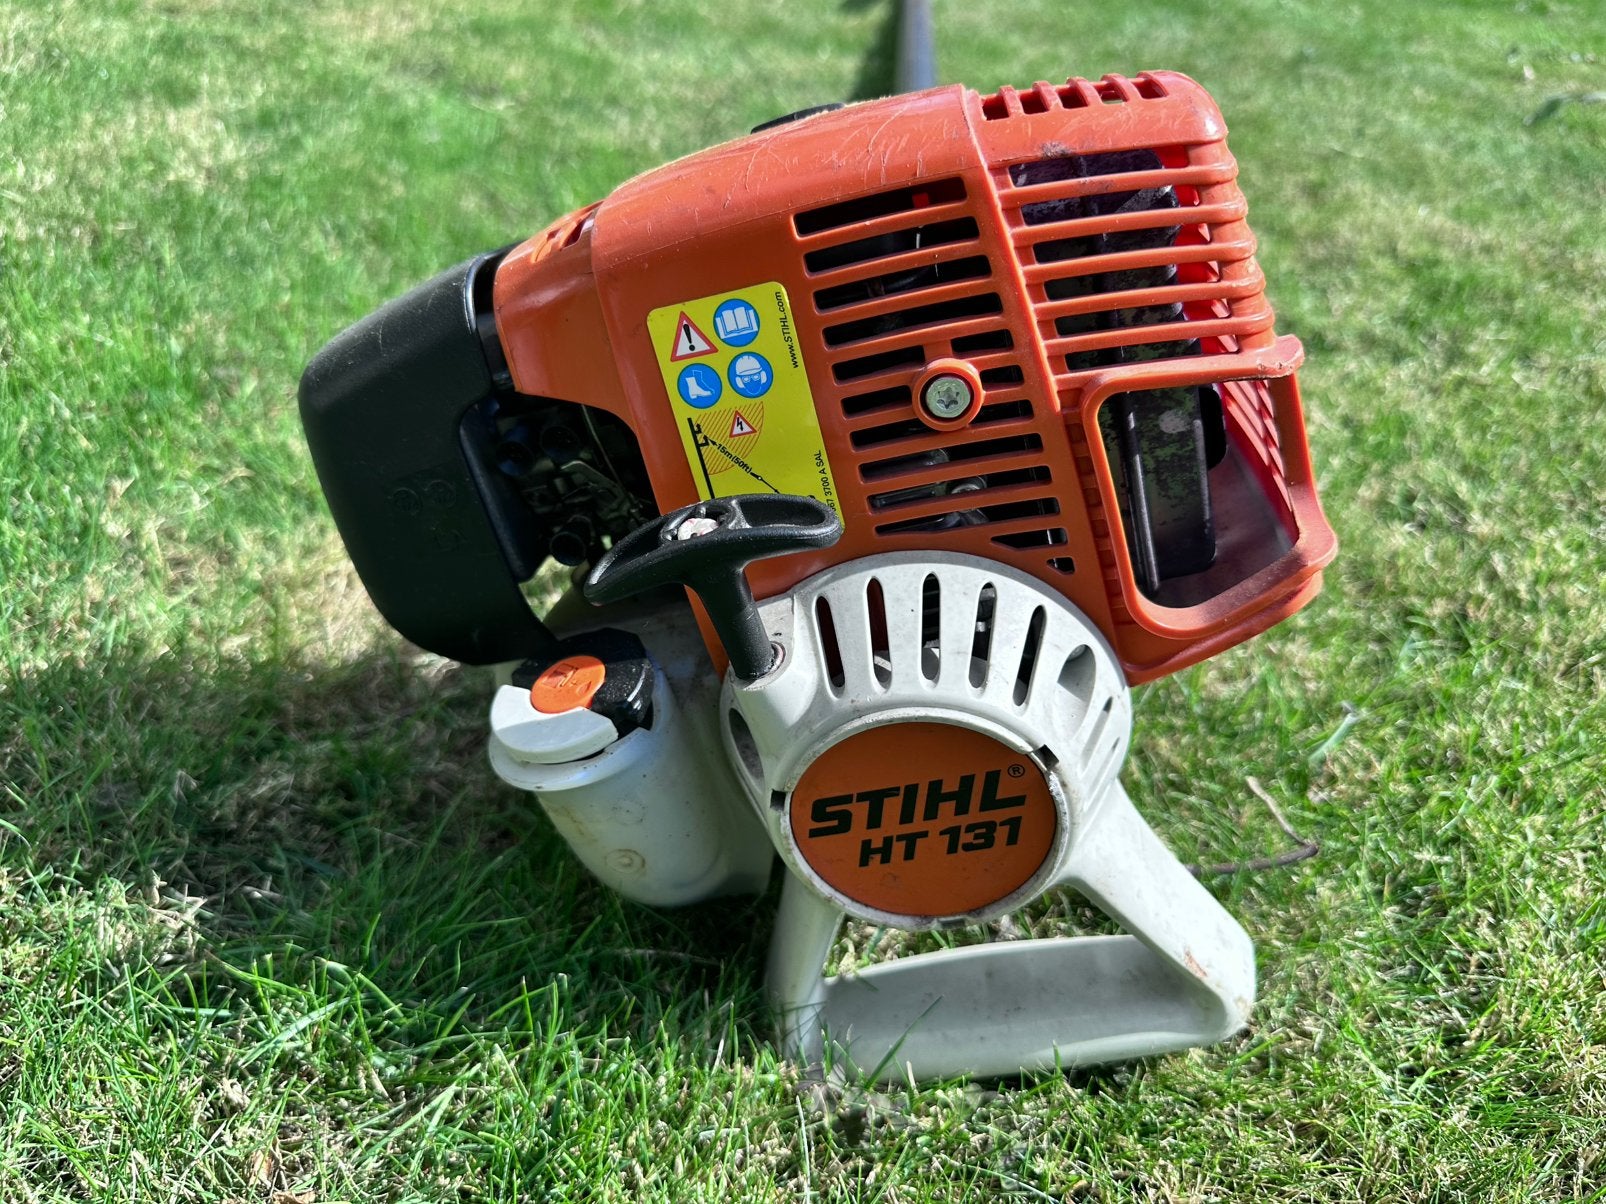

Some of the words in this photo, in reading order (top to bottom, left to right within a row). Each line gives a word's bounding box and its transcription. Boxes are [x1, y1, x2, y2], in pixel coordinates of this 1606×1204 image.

[775, 291, 799, 369] www.STIHL.com
[716, 443, 753, 474] 15m(50ft)
[813, 449, 825, 468] SAL
[818, 467, 827, 475] A
[820, 476, 832, 497] 3700
[858, 830, 929, 867] HT
[939, 816, 1023, 855] 131
